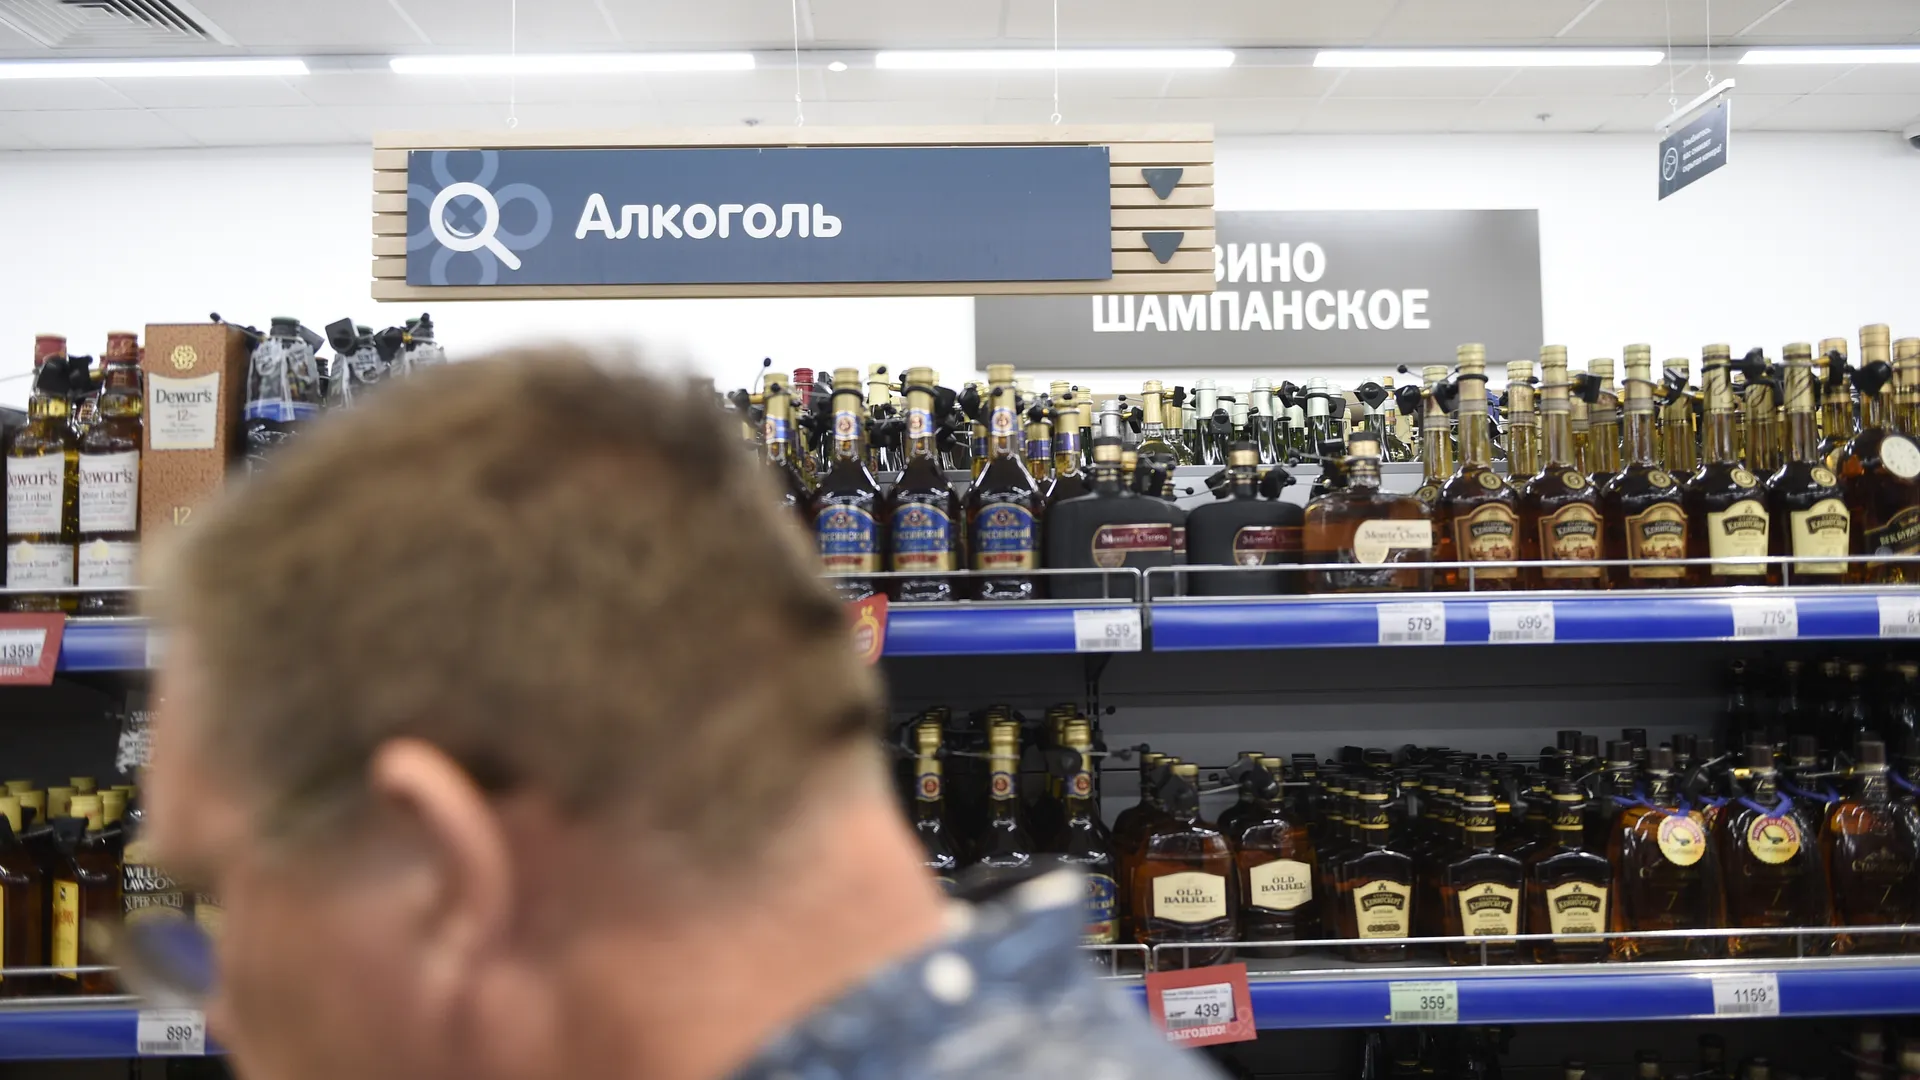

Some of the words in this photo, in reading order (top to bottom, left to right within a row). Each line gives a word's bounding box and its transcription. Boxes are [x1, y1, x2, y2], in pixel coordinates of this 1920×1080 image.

[575, 193, 842, 239] Алкоголь
[1092, 288, 1431, 333] ШАМПАНСКОЕ
[155, 388, 213, 404] Dewar's
[176, 409, 190, 422] 12
[173, 506, 192, 526] 12
[1407, 617, 1432, 630] 579
[1517, 615, 1542, 629] 699
[1762, 611, 1786, 624] 779
[1105, 623, 1130, 637] 639
[3, 644, 34, 658] 1359
[1261, 882, 1306, 892] BARREL
[1272, 876, 1295, 884] OLD
[1164, 895, 1216, 904] BARREL
[1734, 987, 1767, 1002] 1159
[1194, 1003, 1220, 1017] 439
[1420, 996, 1445, 1010] 359
[166, 1026, 192, 1041] 899
[1166, 1025, 1227, 1041] ВЫГОДНО!
